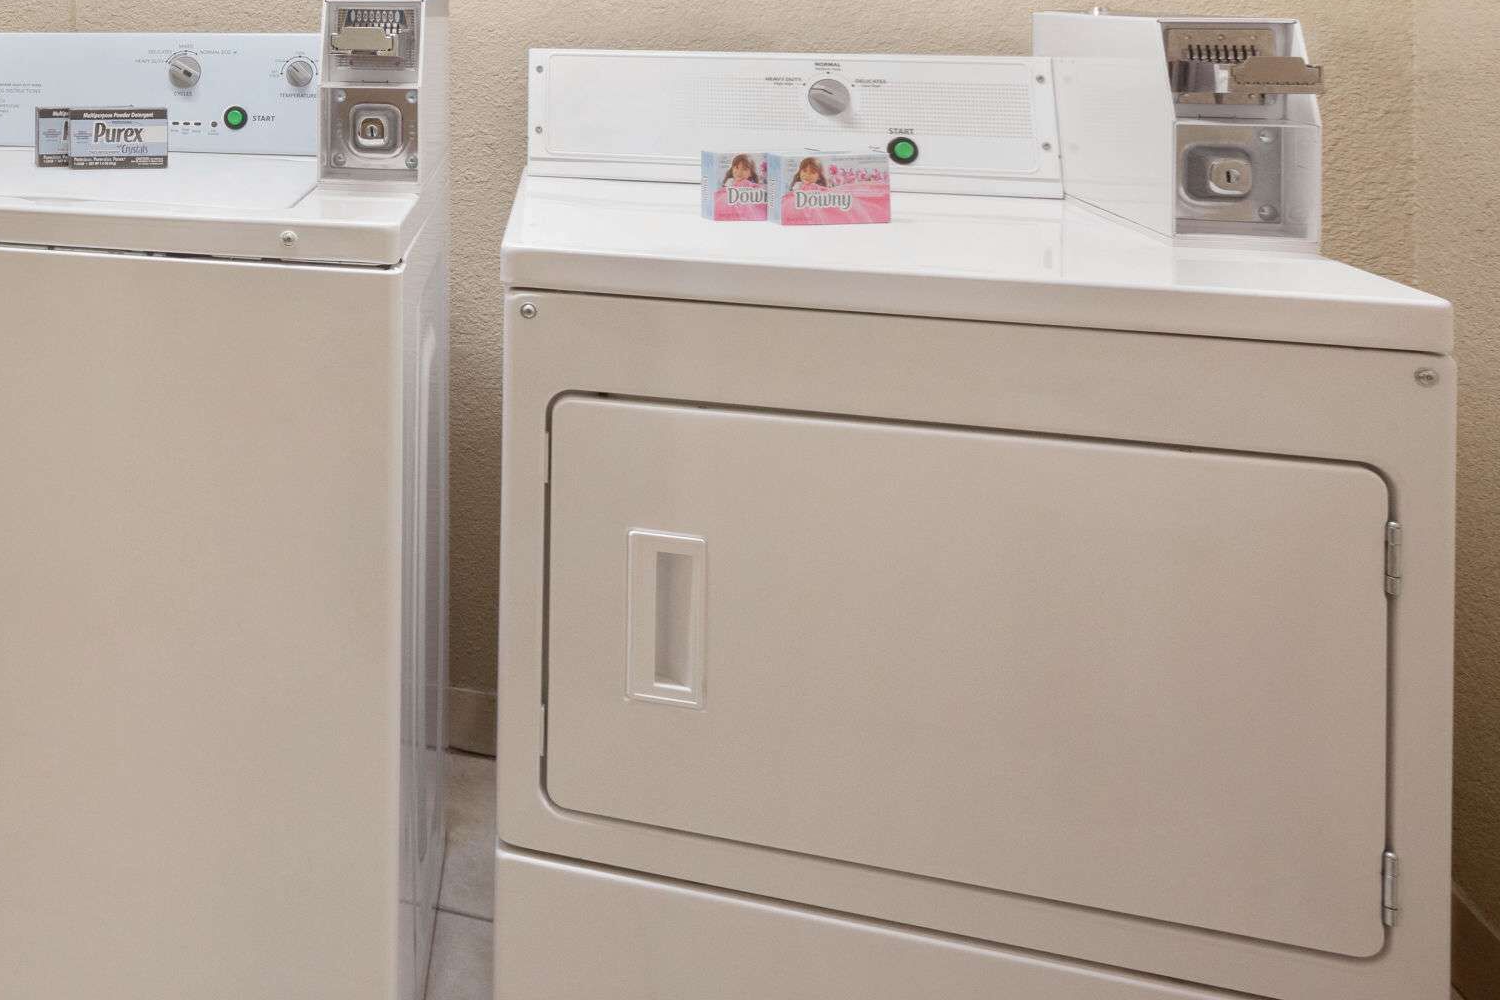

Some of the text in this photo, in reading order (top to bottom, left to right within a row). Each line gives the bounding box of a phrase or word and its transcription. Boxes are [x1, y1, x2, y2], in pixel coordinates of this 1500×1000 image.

[93, 122, 144, 142] Purex
[121, 144, 148, 154] Crystals
[796, 191, 851, 210] Downy
